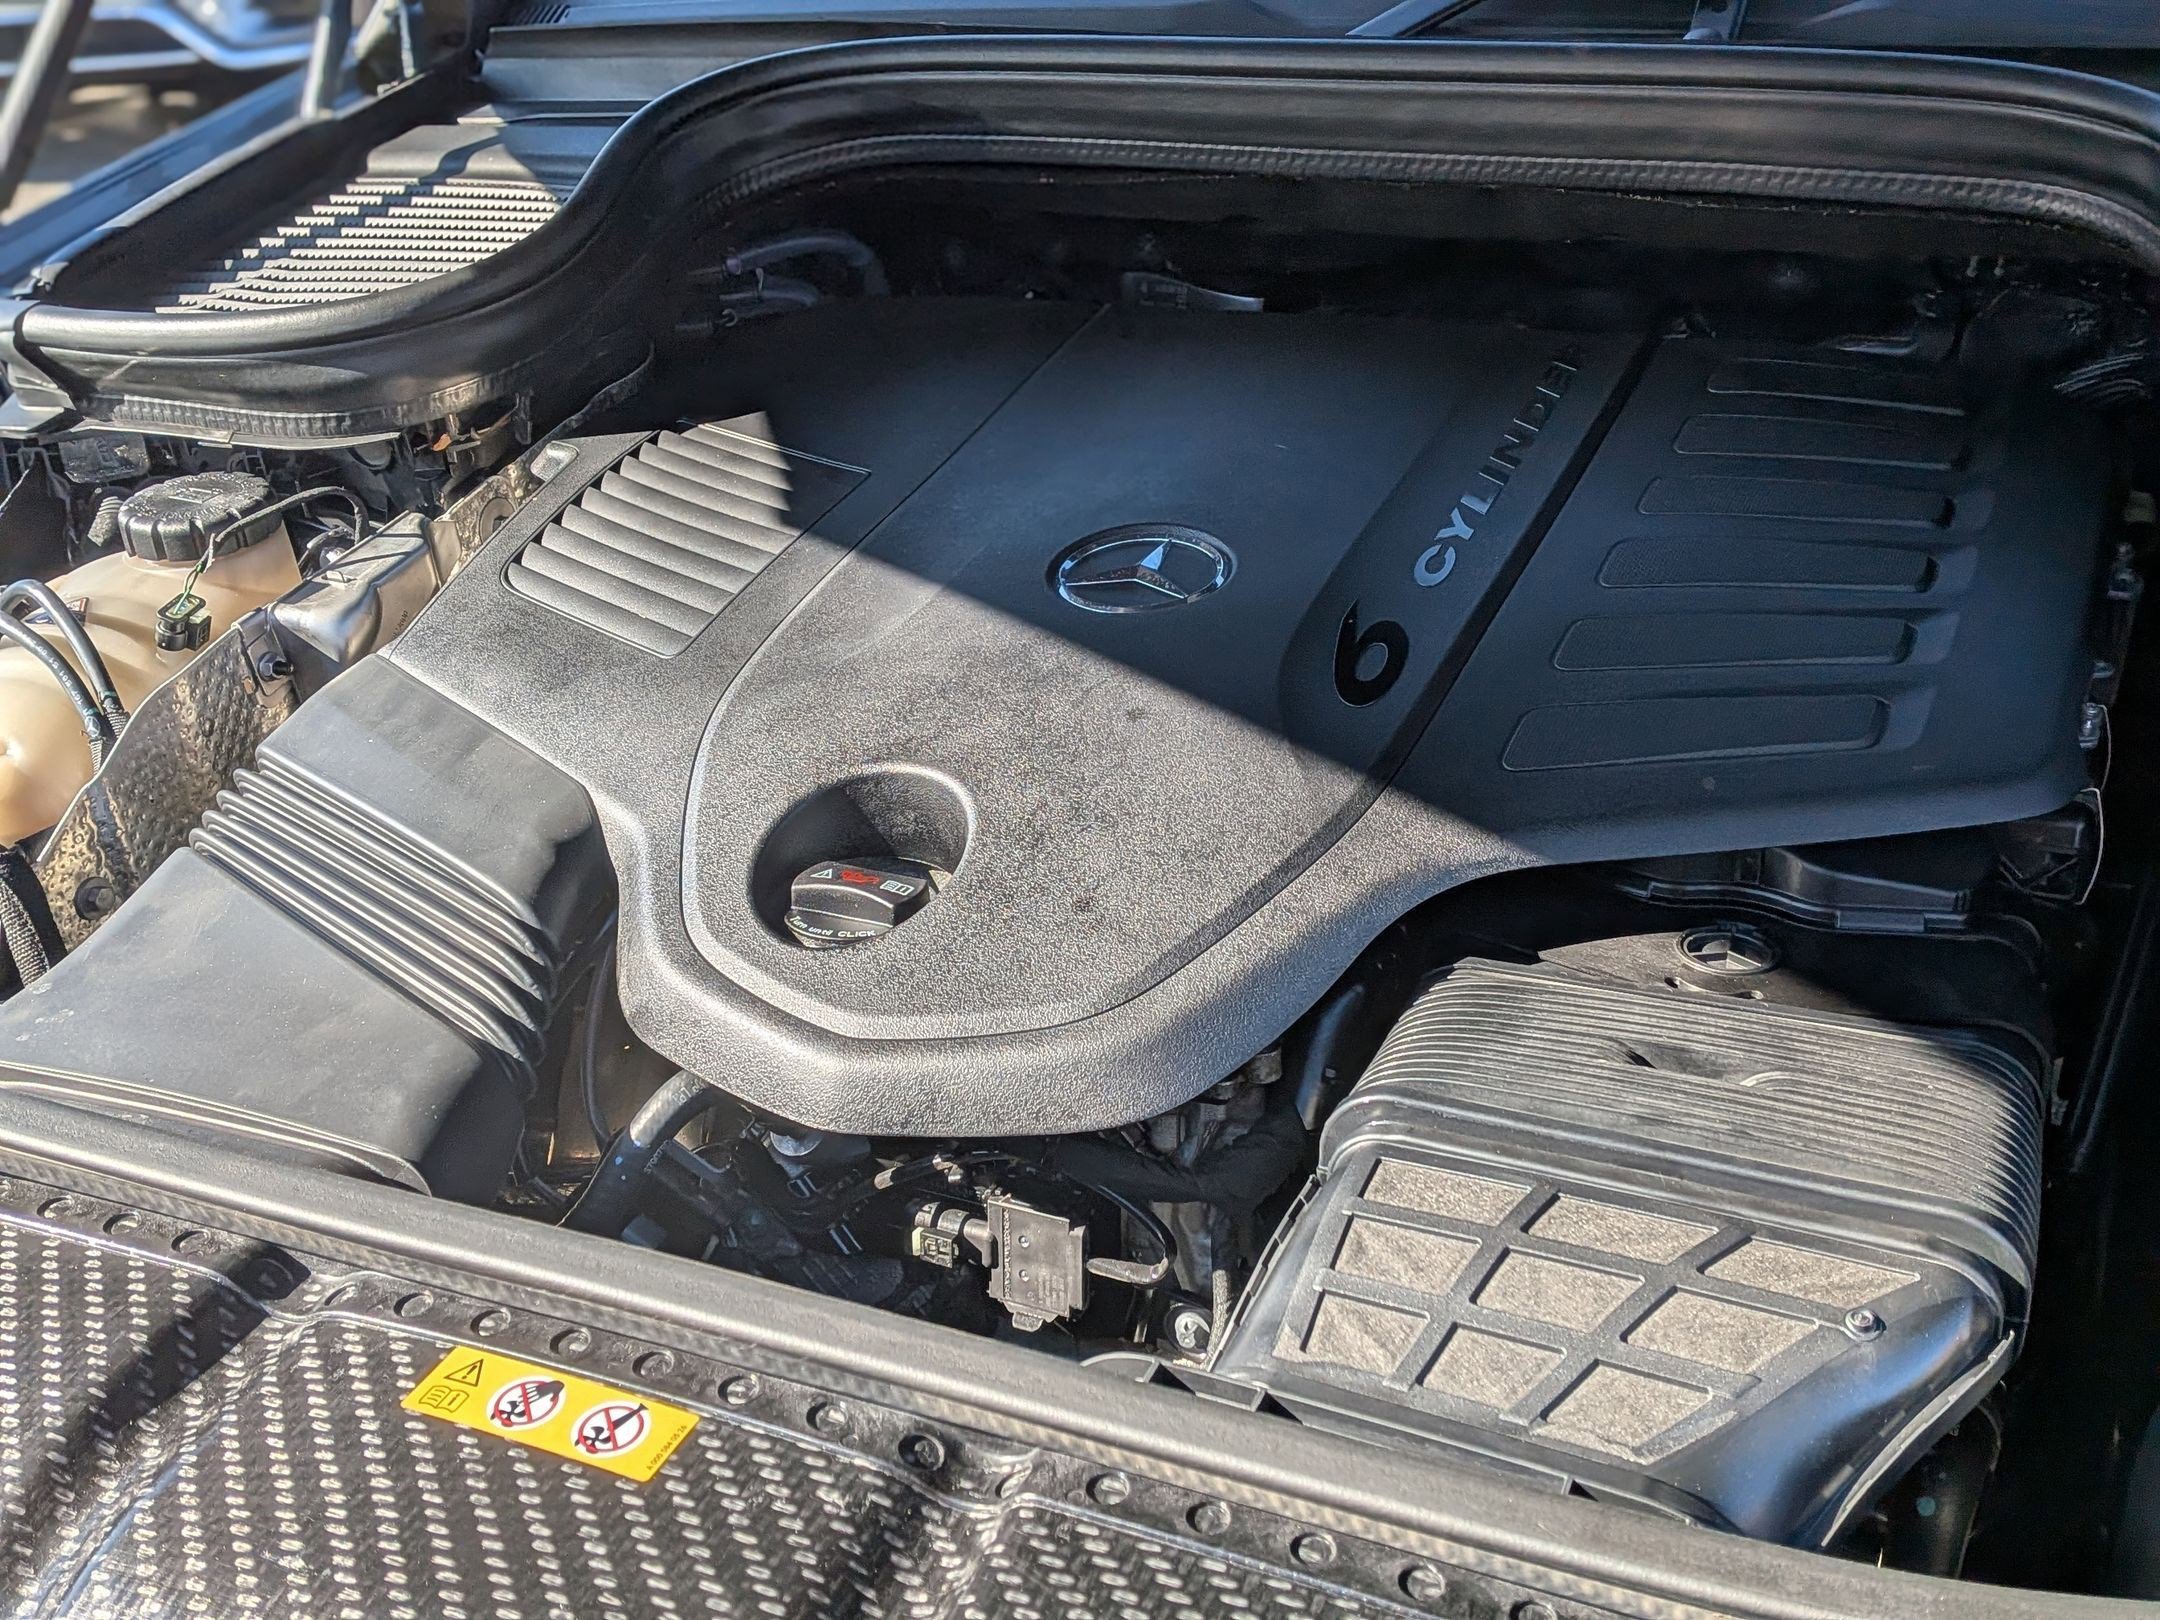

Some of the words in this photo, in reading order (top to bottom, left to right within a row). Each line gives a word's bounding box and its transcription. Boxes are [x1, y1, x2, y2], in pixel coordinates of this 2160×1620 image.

[1333, 599, 1410, 708] 6
[789, 915, 808, 929] Turn
[808, 926, 834, 936] until
[837, 929, 877, 938] CLICK
